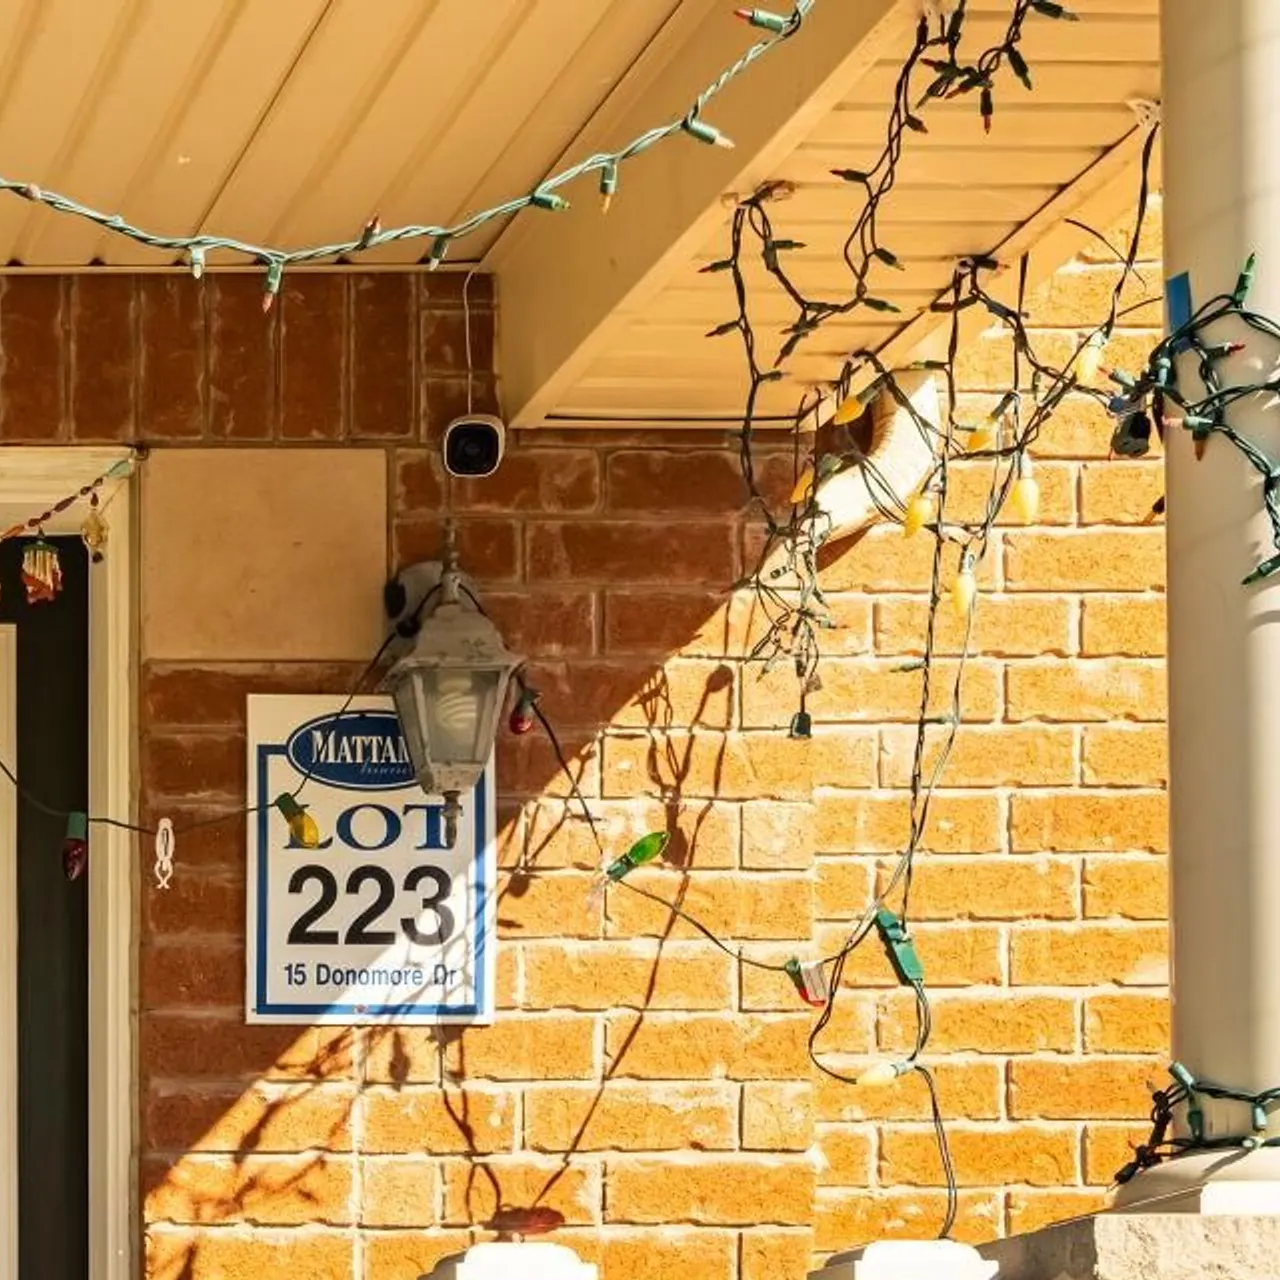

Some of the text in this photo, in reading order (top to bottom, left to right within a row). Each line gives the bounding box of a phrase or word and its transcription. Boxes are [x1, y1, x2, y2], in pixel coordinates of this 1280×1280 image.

[287, 864, 455, 947] 223
[284, 963, 457, 986] 15 Donomore Dr
